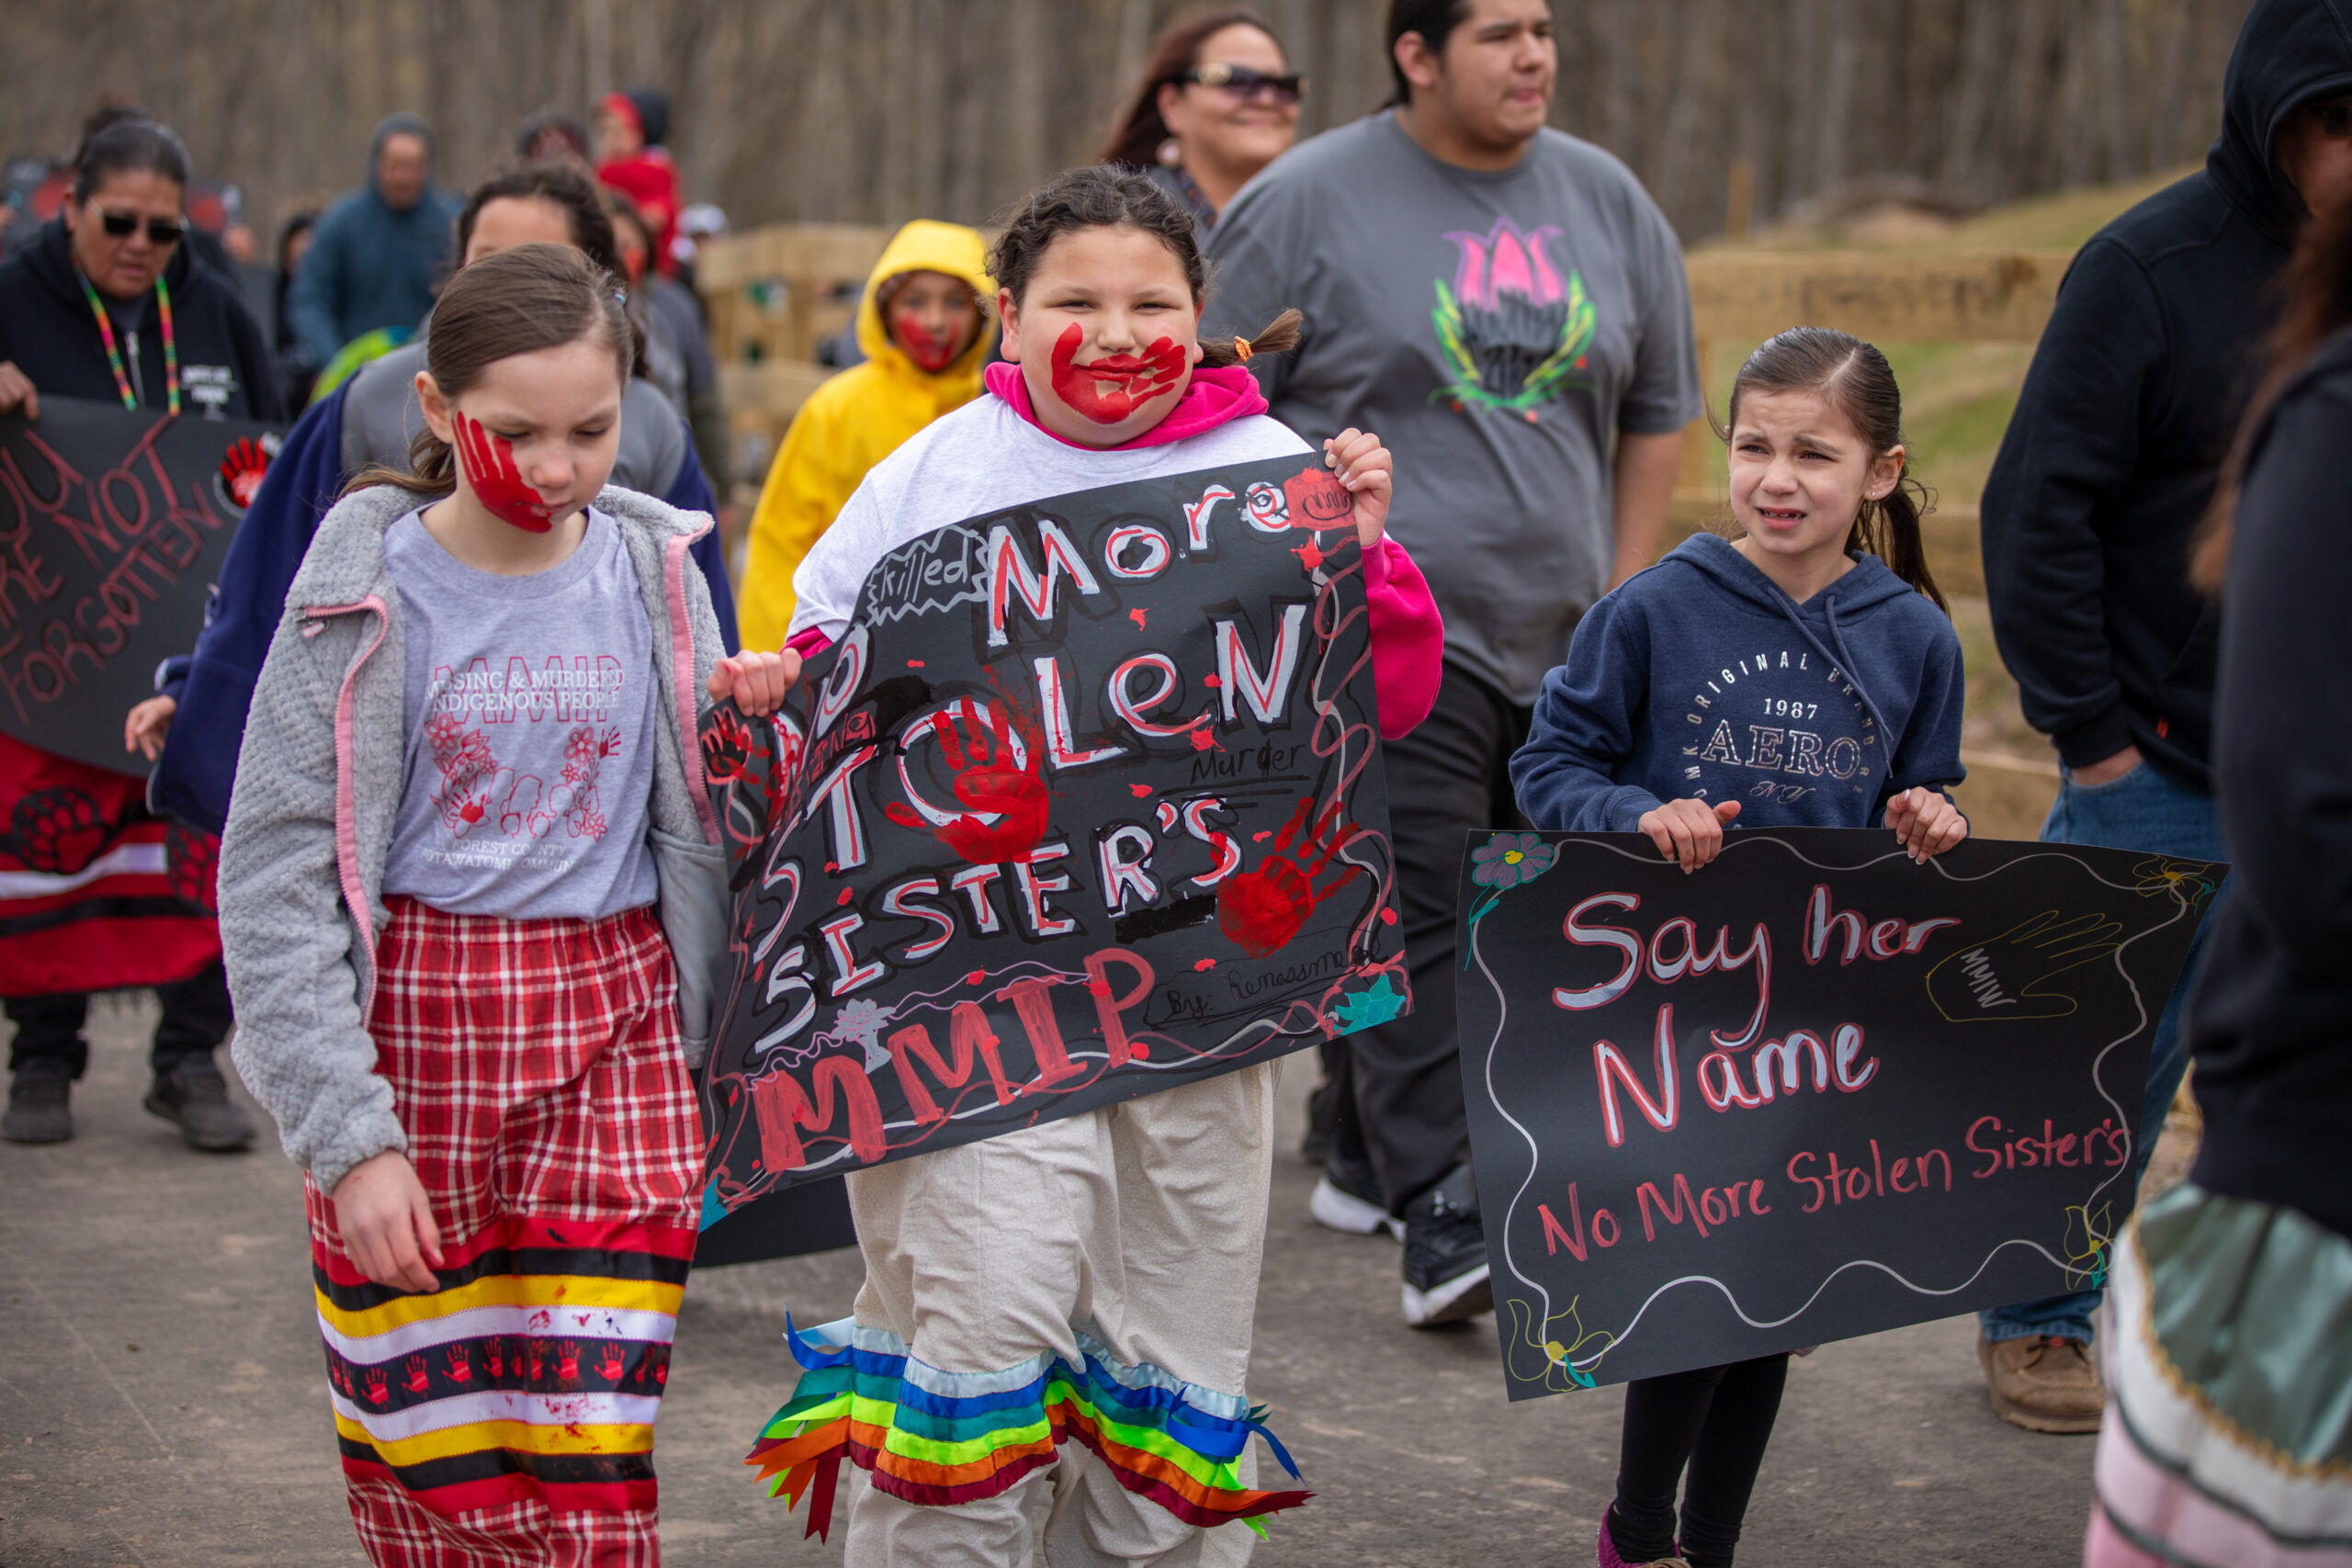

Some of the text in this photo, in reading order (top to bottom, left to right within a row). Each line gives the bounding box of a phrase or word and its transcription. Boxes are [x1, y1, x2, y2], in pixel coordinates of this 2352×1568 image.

[52, 412, 180, 571] NOT
[880, 536, 968, 603] killed
[986, 482, 1294, 649] More
[433, 692, 554, 712] NDIGENOUS
[509, 671, 526, 689] &
[531, 669, 626, 689] MURDERED
[1687, 651, 1808, 725] ORIGINAL
[1763, 697, 1818, 720] 1987
[1191, 739, 1306, 784] Murder
[1700, 719, 1860, 780] AERO
[453, 839, 507, 855] FOREST
[1553, 883, 1962, 1051] Say her
[1961, 947, 2018, 1009] MMIW
[752, 948, 1156, 1174] MMIP
[1593, 1002, 1881, 1148] Name
[1537, 1115, 2132, 1262] No More Stolen Sister's
